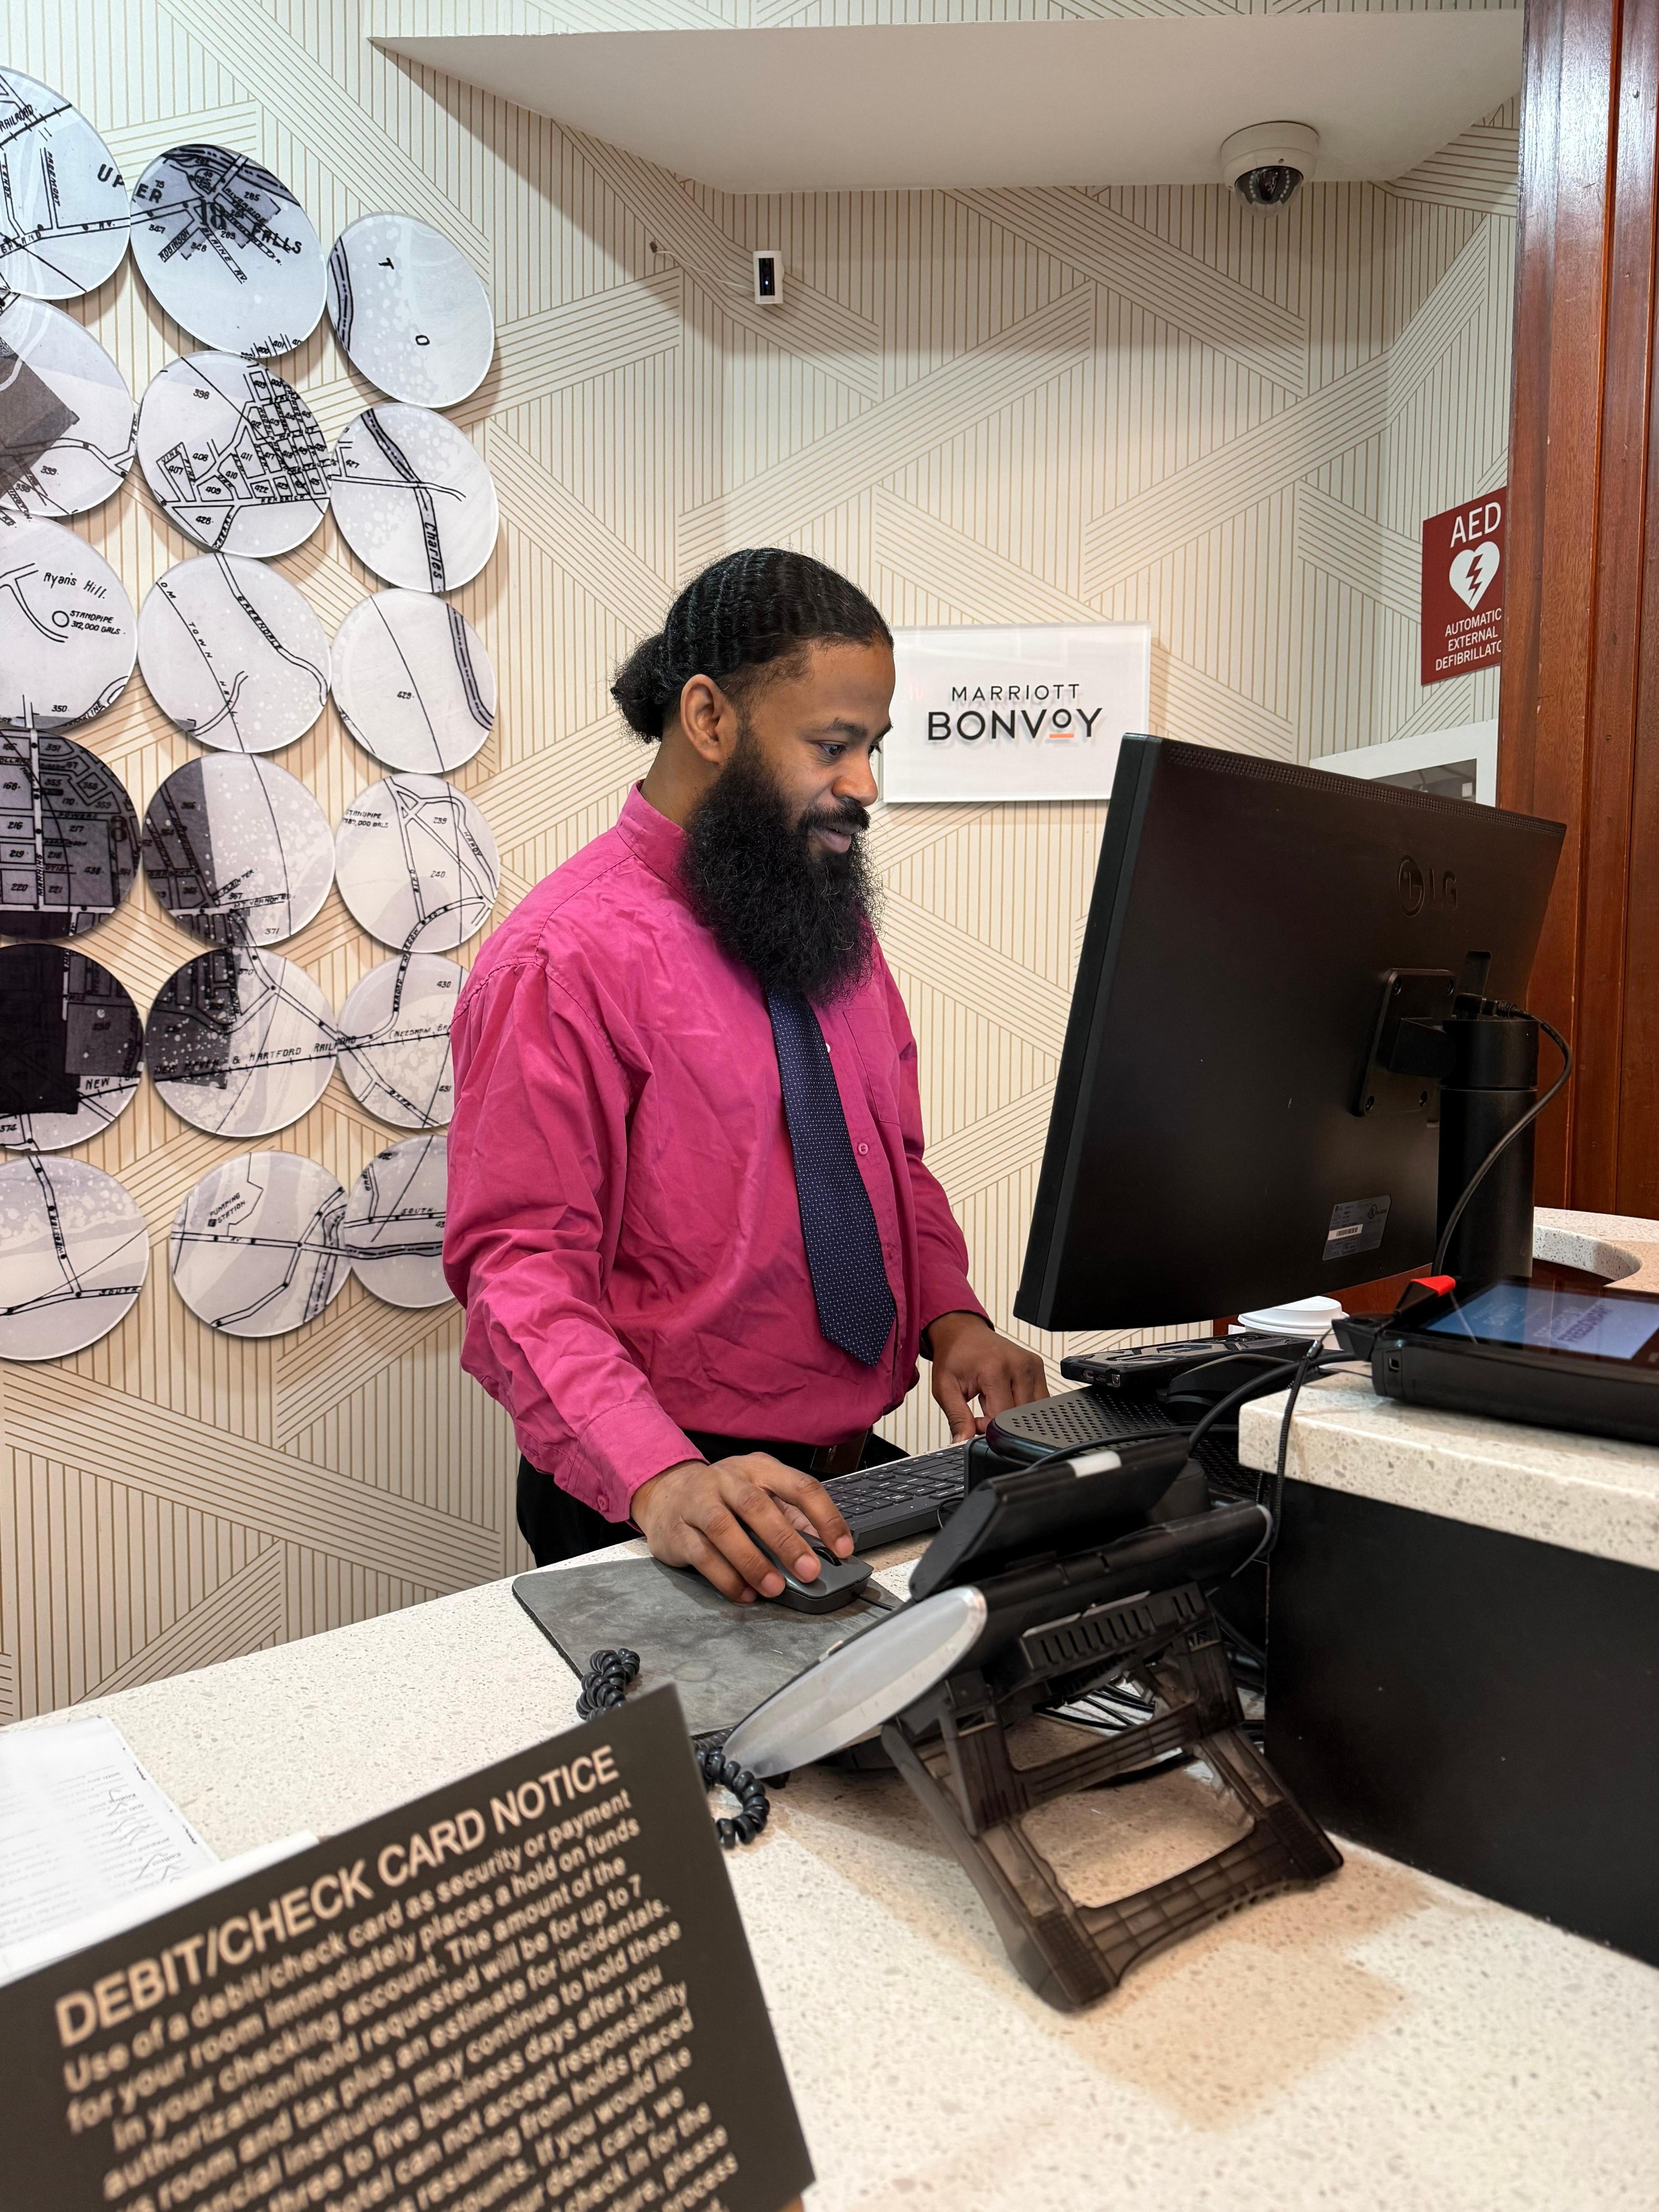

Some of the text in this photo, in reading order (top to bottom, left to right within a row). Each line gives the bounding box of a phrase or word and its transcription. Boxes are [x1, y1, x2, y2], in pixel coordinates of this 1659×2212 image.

[168, 465, 184, 475] 407
[192, 453, 209, 462] 408
[1450, 501, 1501, 548] AED
[424, 522, 442, 580] Charles
[70, 610, 114, 623] STANDPIPE
[1445, 608, 1502, 637] AUTOMATIC
[189, 622, 213, 658] TOWN
[1436, 639, 1502, 671] DEFIBRILLATO
[1448, 626, 1498, 652] EXTERNAL
[52, 704, 67, 713] 350
[951, 684, 1080, 702] MARRIOTT
[928, 708, 1103, 740] BONVOY
[7, 821, 23, 830] 216
[433, 817, 447, 825] 239
[11, 883, 28, 892] 220
[430, 870, 445, 878] 240
[249, 1047, 302, 1061] HARTFORD
[85, 1077, 110, 1090] NEW
[210, 1192, 240, 1218] PUMPING
[218, 1200, 246, 1223] STATION
[400, 1207, 434, 1216] SOUTH
[56, 1860, 373, 2046] DEBIT/CHECK
[378, 1809, 485, 1886] CARD
[490, 1745, 619, 1833] NOTICE
[64, 1789, 631, 2091] Use of a debit/check card as security or payment
[68, 1819, 639, 2130] for your room immediately places a hold on funds
[114, 1858, 625, 2149] in your checking account. The amount of the
[105, 1874, 640, 2197] authorization/hold requested will be for up to 7
[284, 1922, 680, 2174] institution may continue to hold these
[159, 1899, 670, 2207] room and tax plus an estimate for incidentals.
[344, 2147, 373, 2176] to
[374, 2118, 419, 2157] five
[420, 2052, 524, 2128] business
[525, 2019, 576, 2062] days
[578, 1988, 623, 2030] after
[625, 1966, 662, 2004] you
[395, 1983, 686, 2183] can not accept responsibility
[417, 2008, 693, 2209] resulting from holds placed
[555, 2114, 596, 2158] you
[595, 2068, 656, 2123] would
[655, 2048, 690, 2082] like
[654, 2088, 683, 2118] we
[677, 2104, 710, 2136] the
[663, 2128, 726, 2189] please
